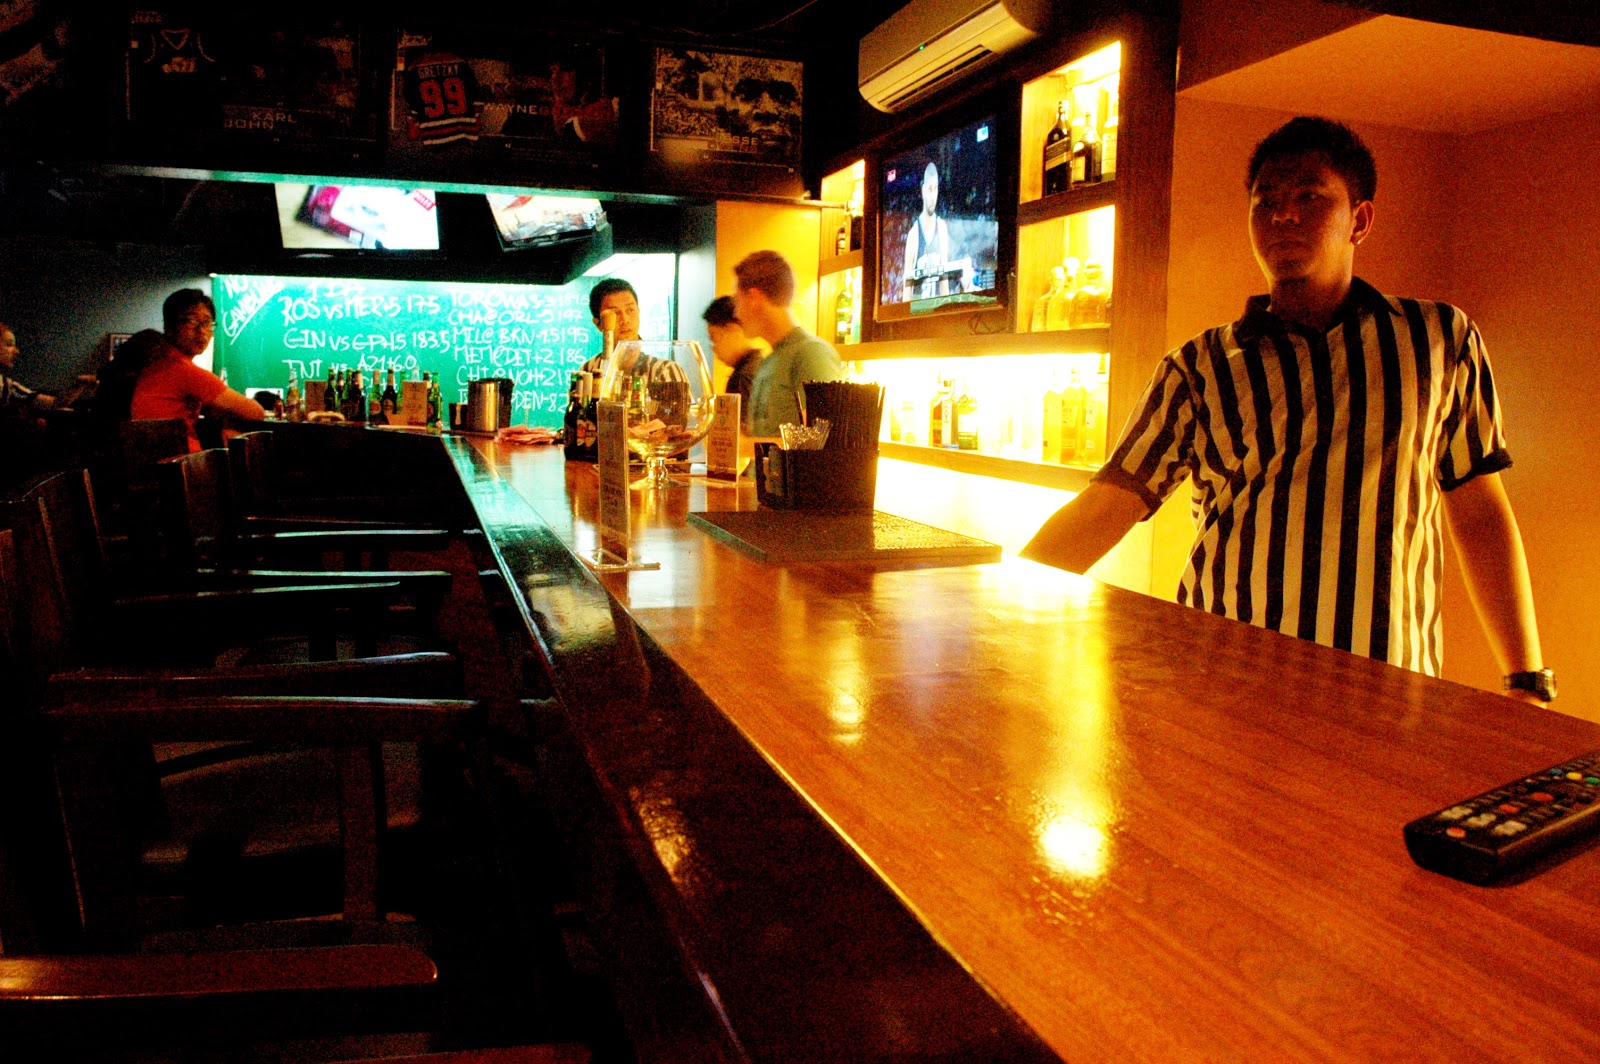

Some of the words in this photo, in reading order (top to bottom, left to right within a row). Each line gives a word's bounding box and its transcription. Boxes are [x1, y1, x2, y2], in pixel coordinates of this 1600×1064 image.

[419, 77, 468, 118] 99
[251, 111, 298, 125] KARL
[224, 275, 249, 298] NO
[277, 295, 321, 327] ROS
[323, 303, 344, 320] vs
[407, 294, 441, 315] 175
[559, 348, 587, 365] 186
[281, 357, 323, 380] TNT
